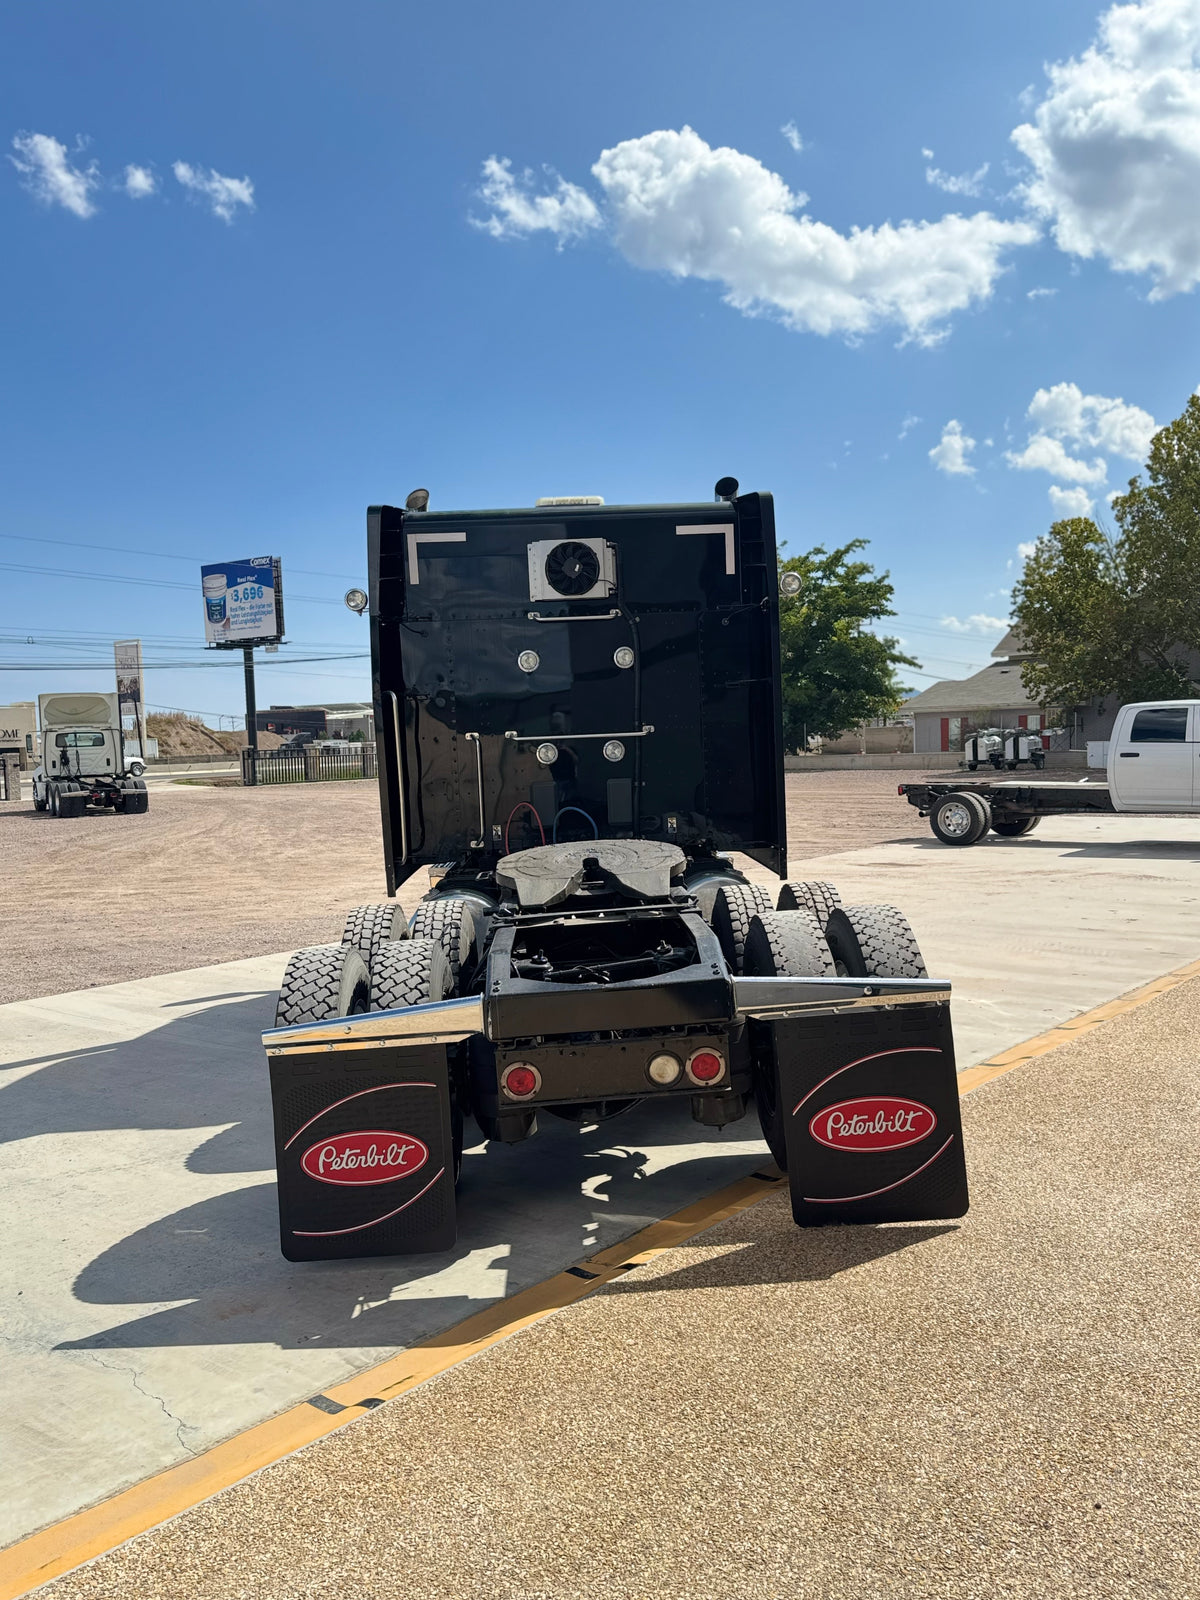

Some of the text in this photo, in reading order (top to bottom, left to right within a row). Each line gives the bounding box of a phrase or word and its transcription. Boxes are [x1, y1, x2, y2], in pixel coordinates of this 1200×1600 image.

[250, 557, 270, 566] Comex
[827, 1109, 923, 1140] Peterbilt
[318, 1143, 415, 1174] Peterbilt
